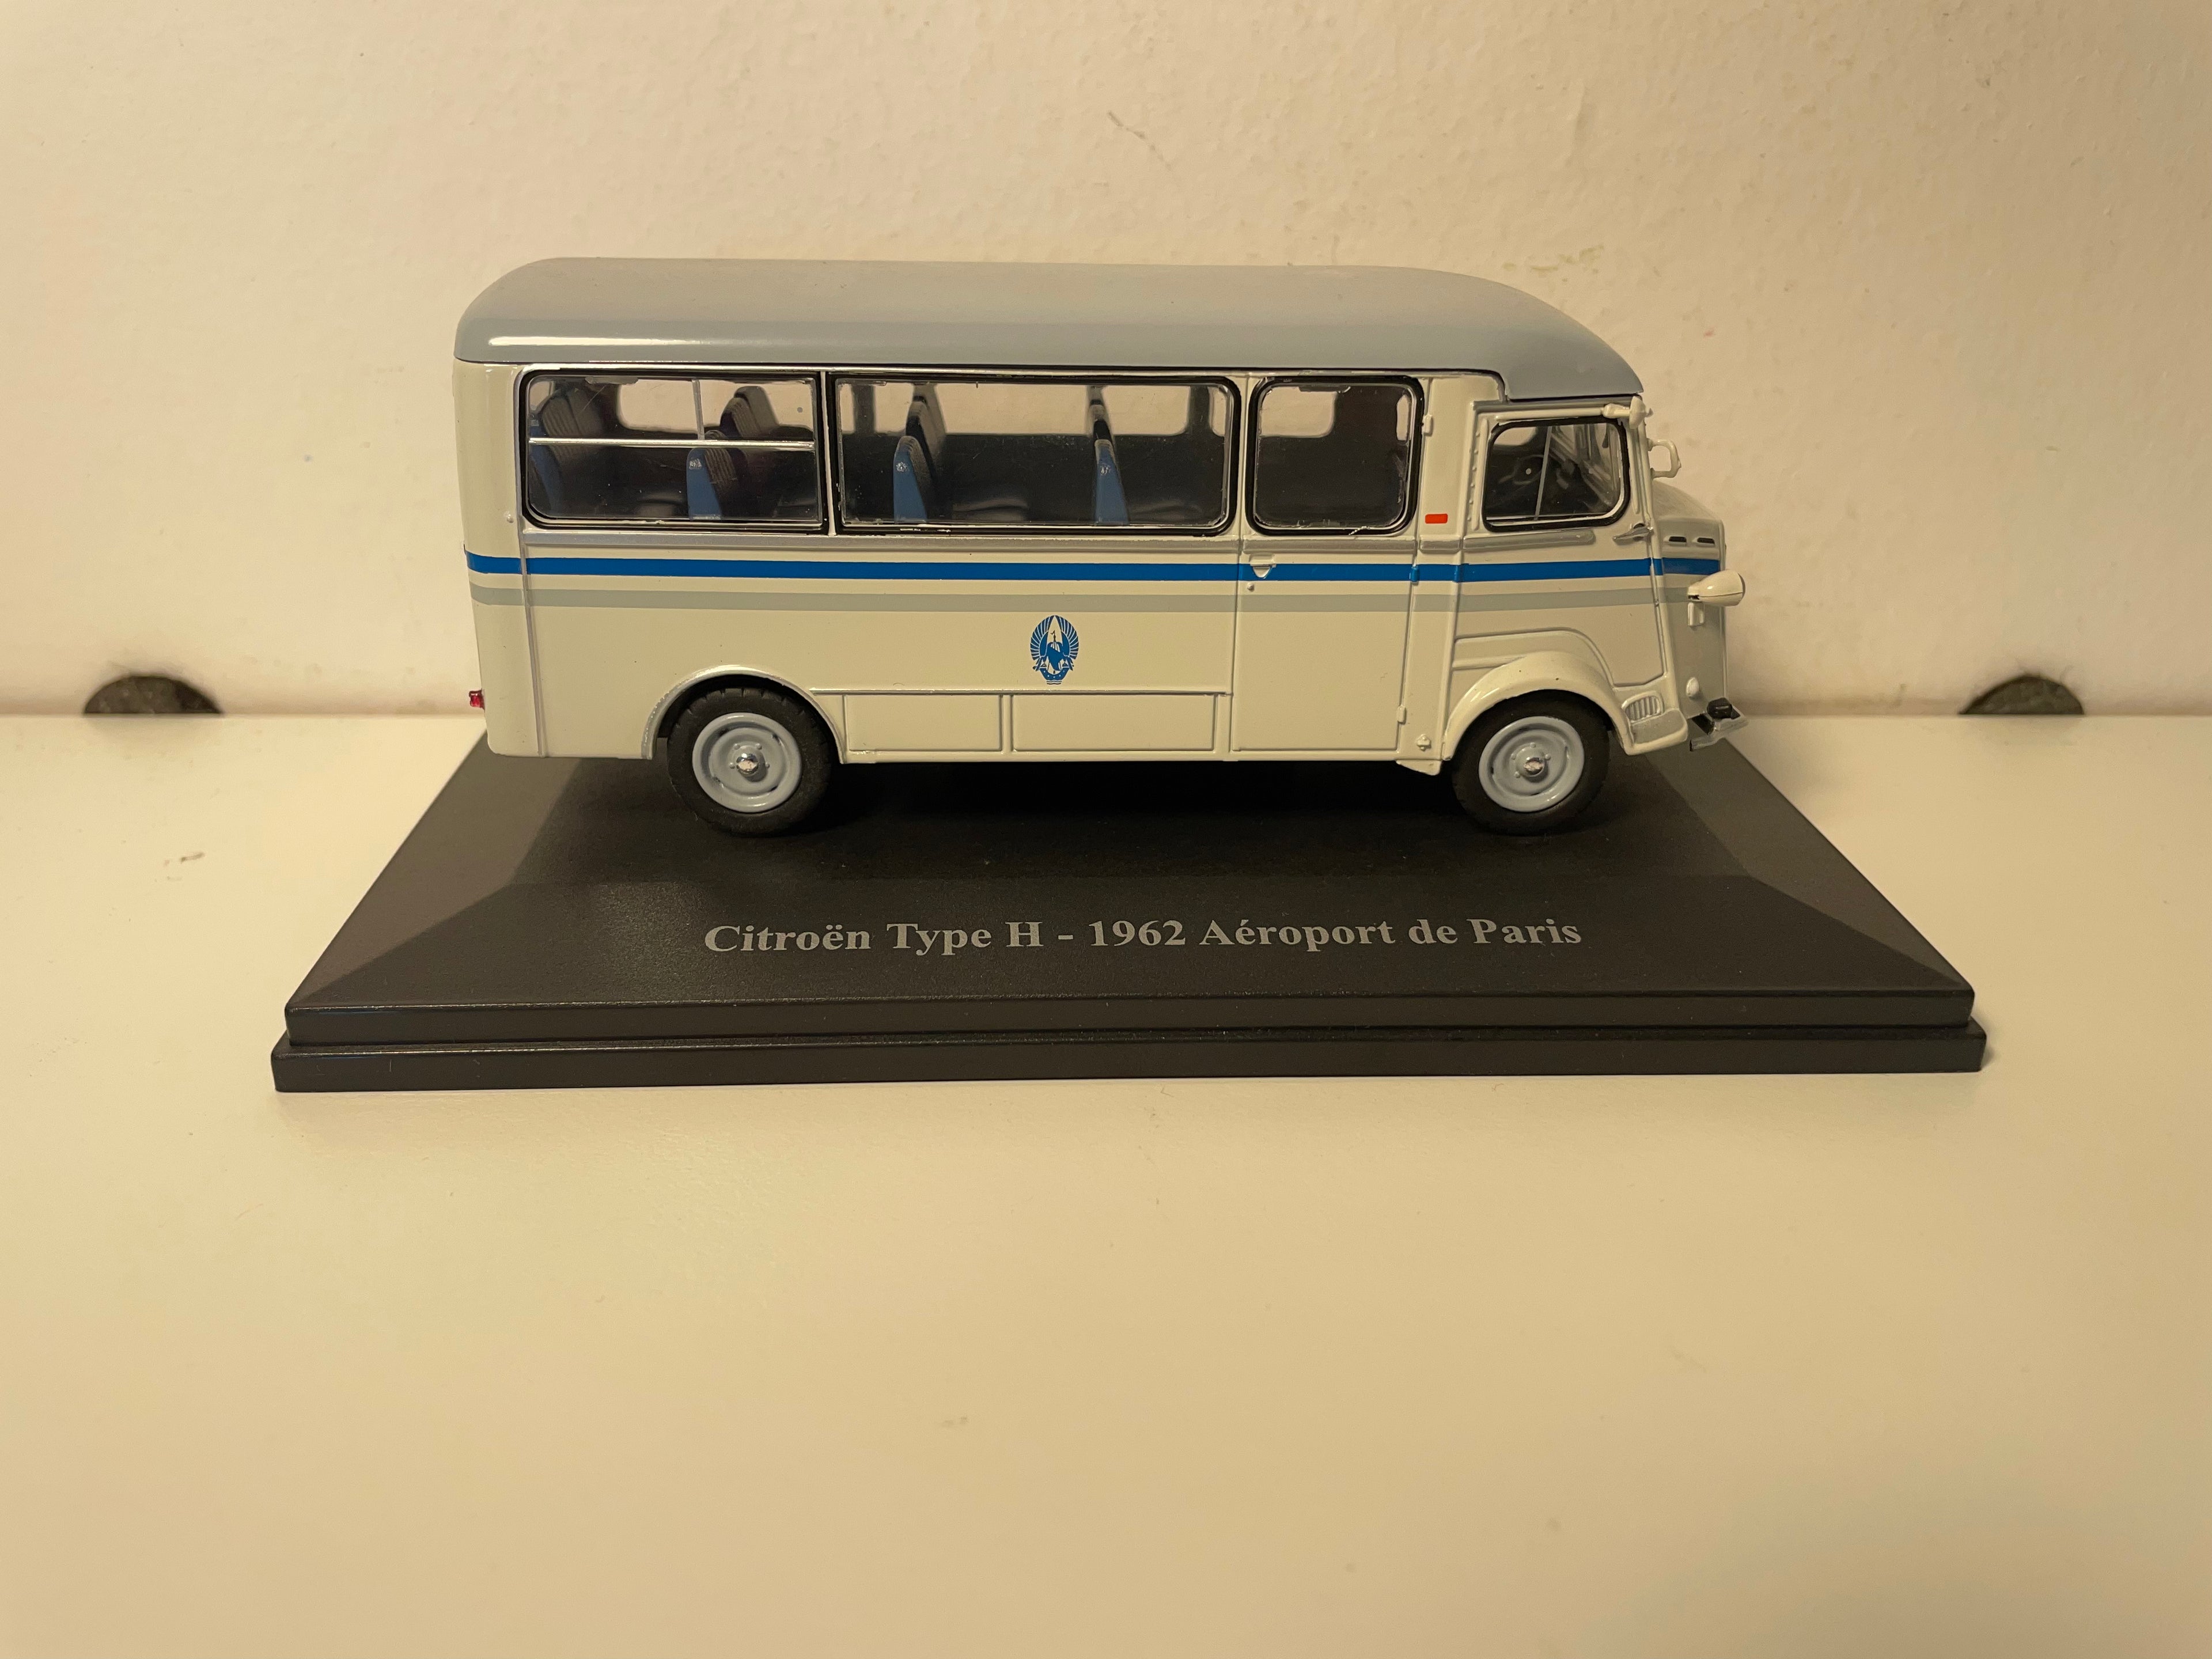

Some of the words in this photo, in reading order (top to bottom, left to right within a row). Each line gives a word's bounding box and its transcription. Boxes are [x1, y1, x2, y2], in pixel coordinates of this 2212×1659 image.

[704, 925, 871, 952] Citroën
[887, 923, 991, 956] Type
[1005, 922, 1044, 947] H
[1089, 920, 1185, 946] 1962
[1199, 919, 1396, 952] Aéroport
[1408, 919, 1457, 944] de
[1468, 919, 1582, 944] Paris
